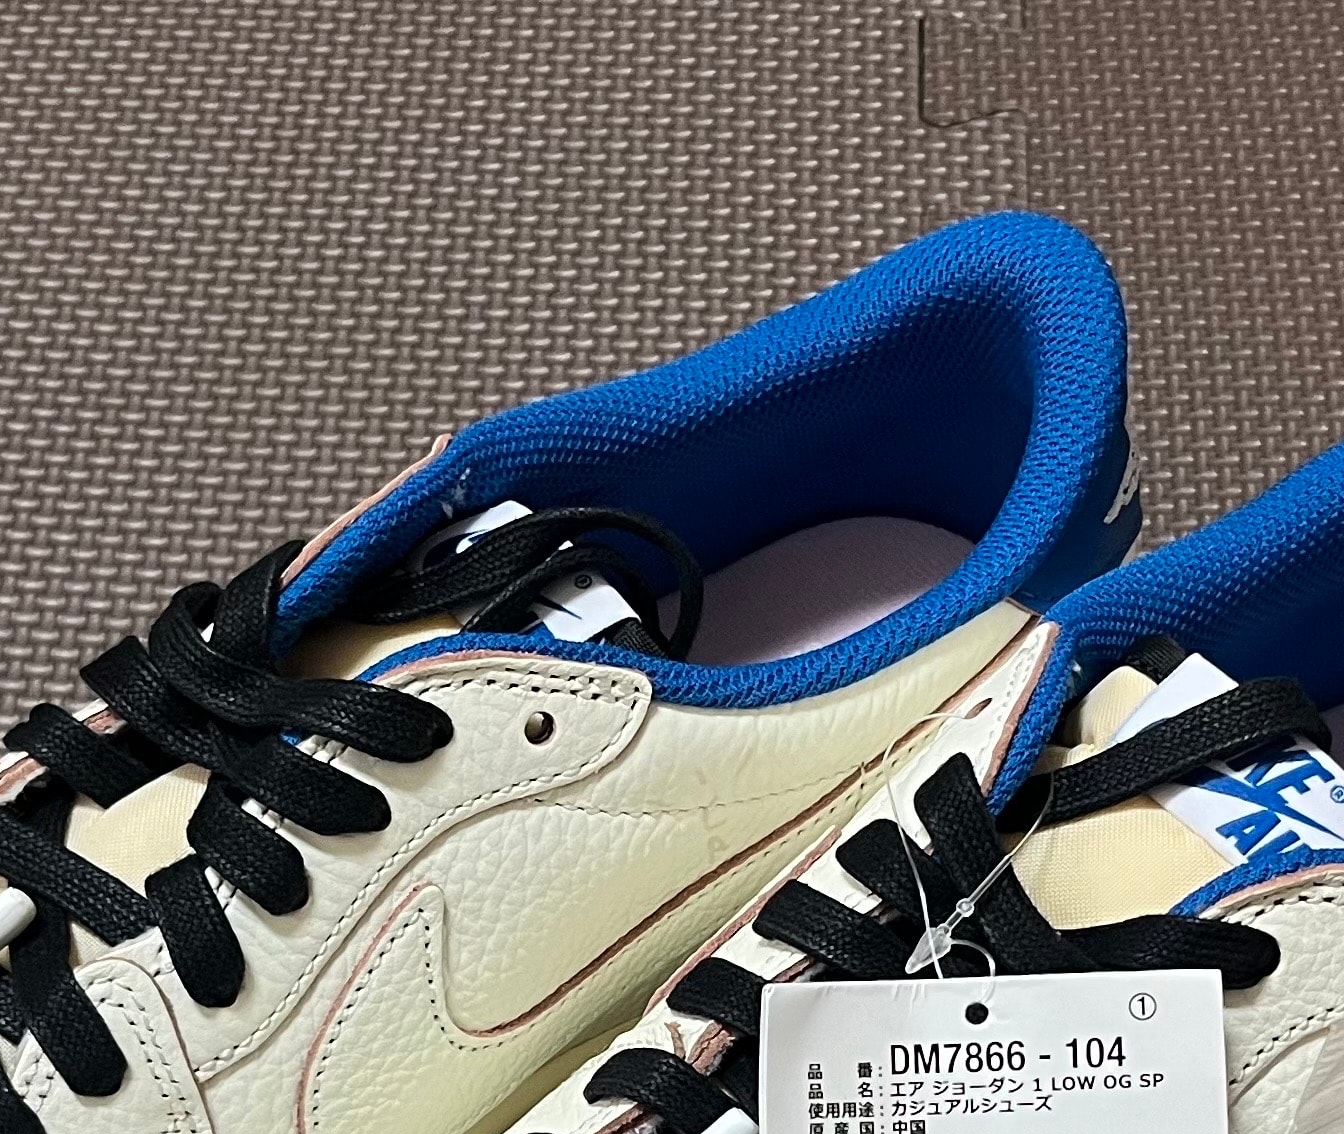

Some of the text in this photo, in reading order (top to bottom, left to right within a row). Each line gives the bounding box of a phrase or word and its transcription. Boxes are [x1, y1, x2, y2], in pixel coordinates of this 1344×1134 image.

[890, 1040, 1026, 1075] DM7866
[1066, 1036, 1127, 1069] 104
[1051, 1076, 1096, 1091] LOW
[1103, 1074, 1132, 1089] OG
[1139, 1073, 1164, 1088] SP
